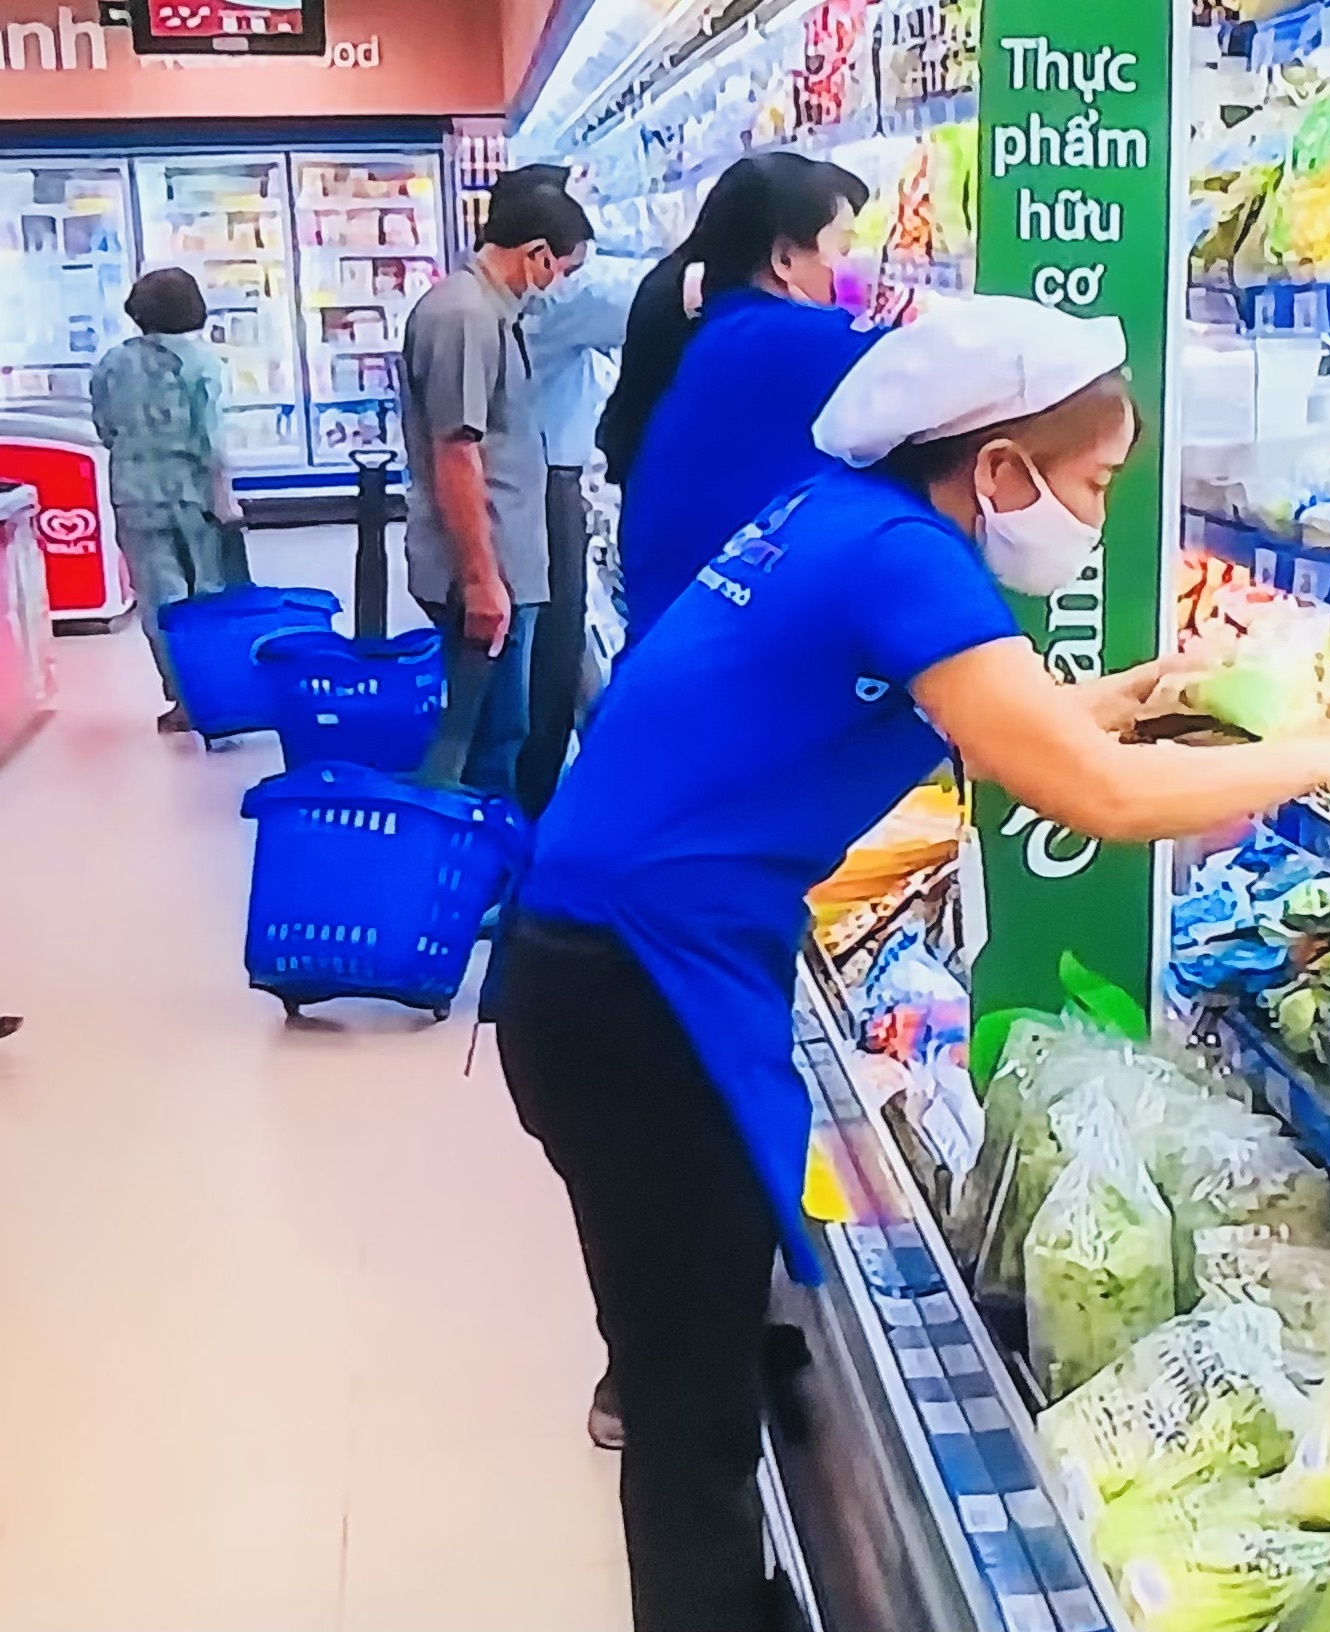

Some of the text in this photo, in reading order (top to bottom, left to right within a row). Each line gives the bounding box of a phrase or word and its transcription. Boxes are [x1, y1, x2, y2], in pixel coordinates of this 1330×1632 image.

[0, 6, 107, 70] nh
[1000, 36, 1137, 103] Thực
[994, 108, 1147, 177] phẩm
[1020, 187, 1121, 242] hữu
[1034, 263, 1104, 306] cơ
